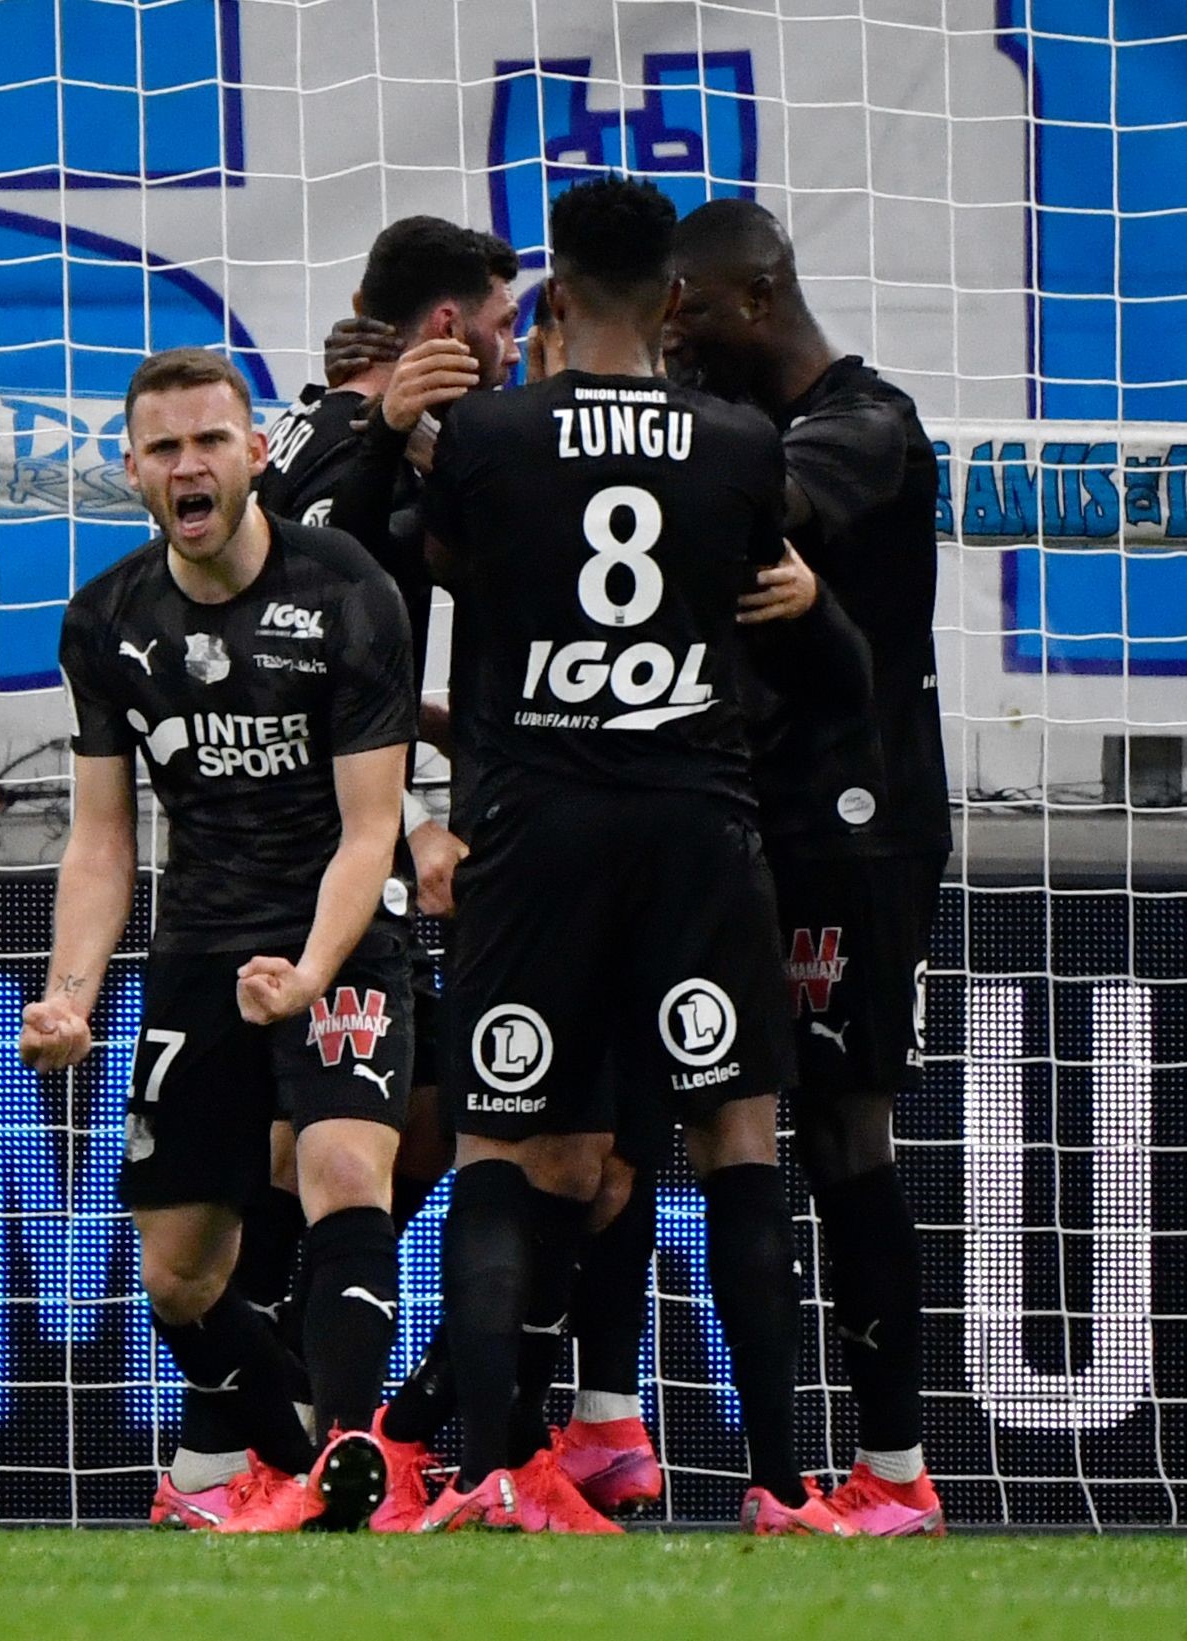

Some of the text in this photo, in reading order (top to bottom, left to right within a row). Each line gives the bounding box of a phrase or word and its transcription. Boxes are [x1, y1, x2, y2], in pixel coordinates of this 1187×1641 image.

[575, 387, 617, 401] UNION
[553, 405, 693, 461] ZUNGU
[578, 485, 663, 628] 8
[260, 602, 324, 636] IGOL
[522, 640, 713, 706] IGOL
[194, 711, 310, 747] INTER
[197, 739, 310, 778] SPORT
